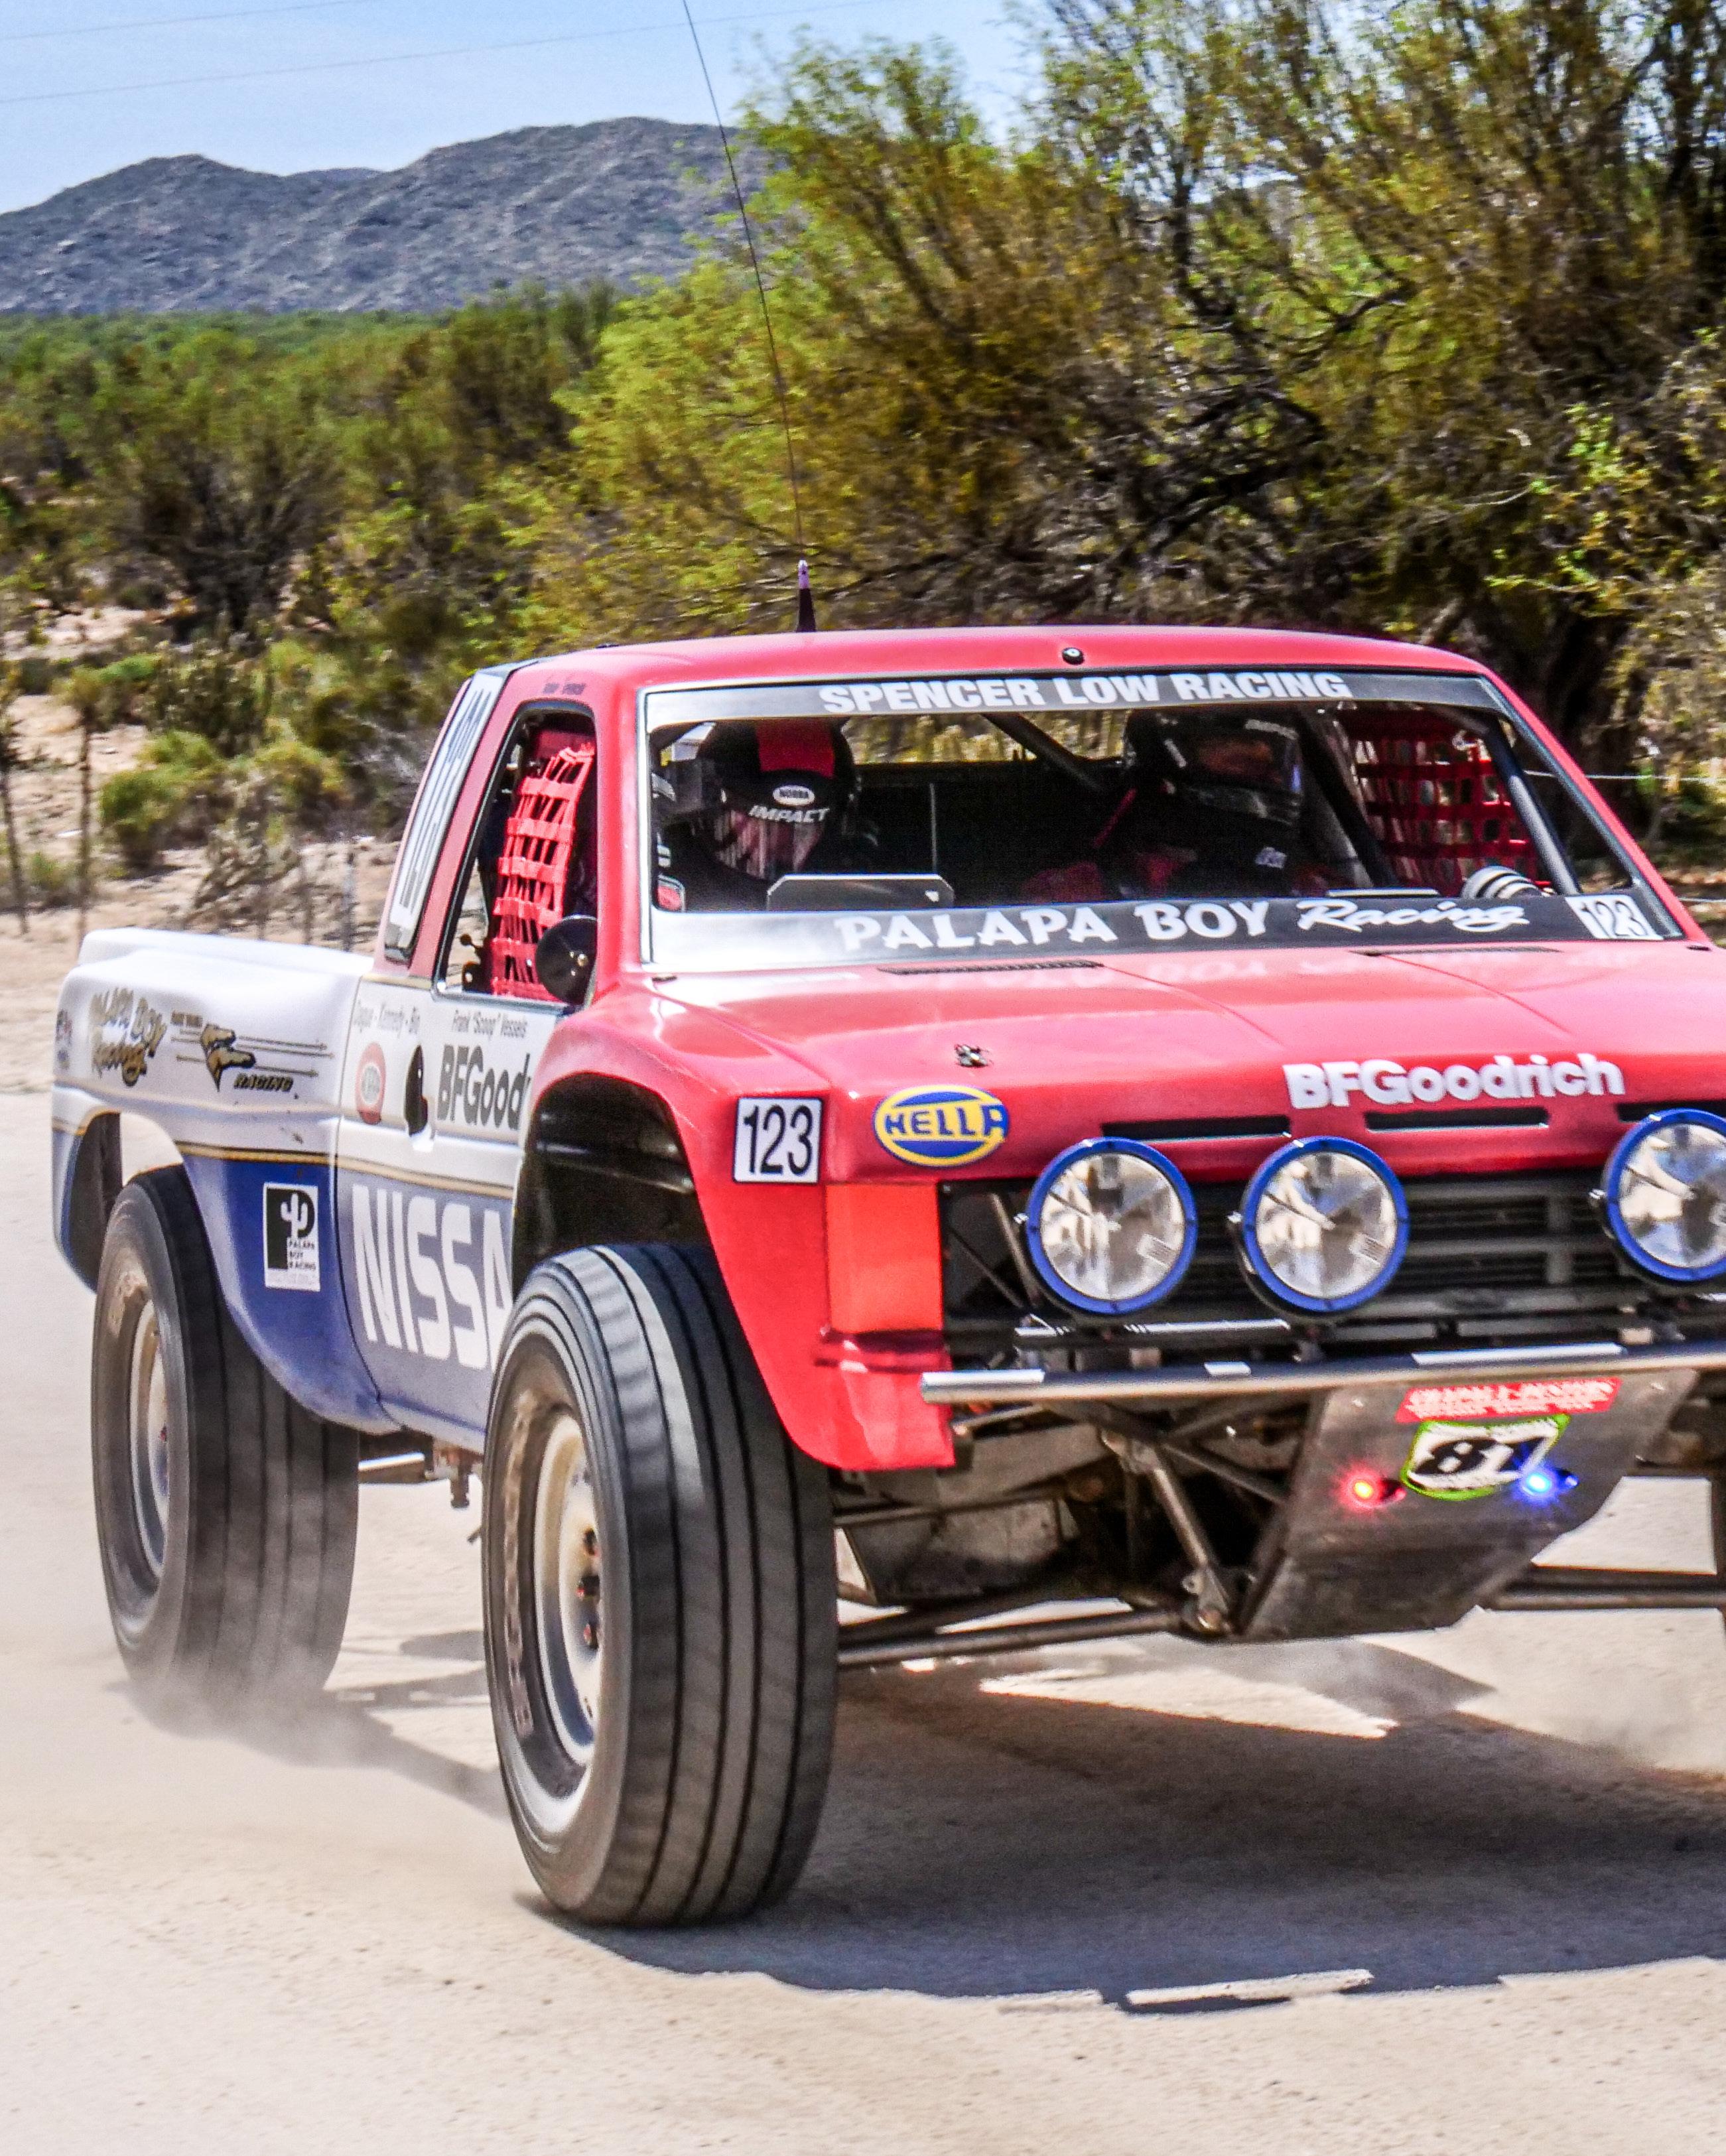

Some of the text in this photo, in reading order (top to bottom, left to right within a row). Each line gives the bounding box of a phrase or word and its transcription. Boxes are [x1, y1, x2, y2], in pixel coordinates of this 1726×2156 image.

[819, 672, 1353, 713] SPENCER LOW RACING
[748, 805, 830, 823] IMPACT
[833, 899, 1530, 951] PALAPA BOY Racing
[1581, 899, 1644, 938] 123
[234, 1073, 294, 1092] RACING
[437, 1044, 531, 1130] BFGood
[1282, 1053, 1626, 1109] BFGoodrich
[744, 1105, 813, 1176] 123
[885, 1104, 1009, 1138] HELLA
[352, 1183, 513, 1375] NISSA
